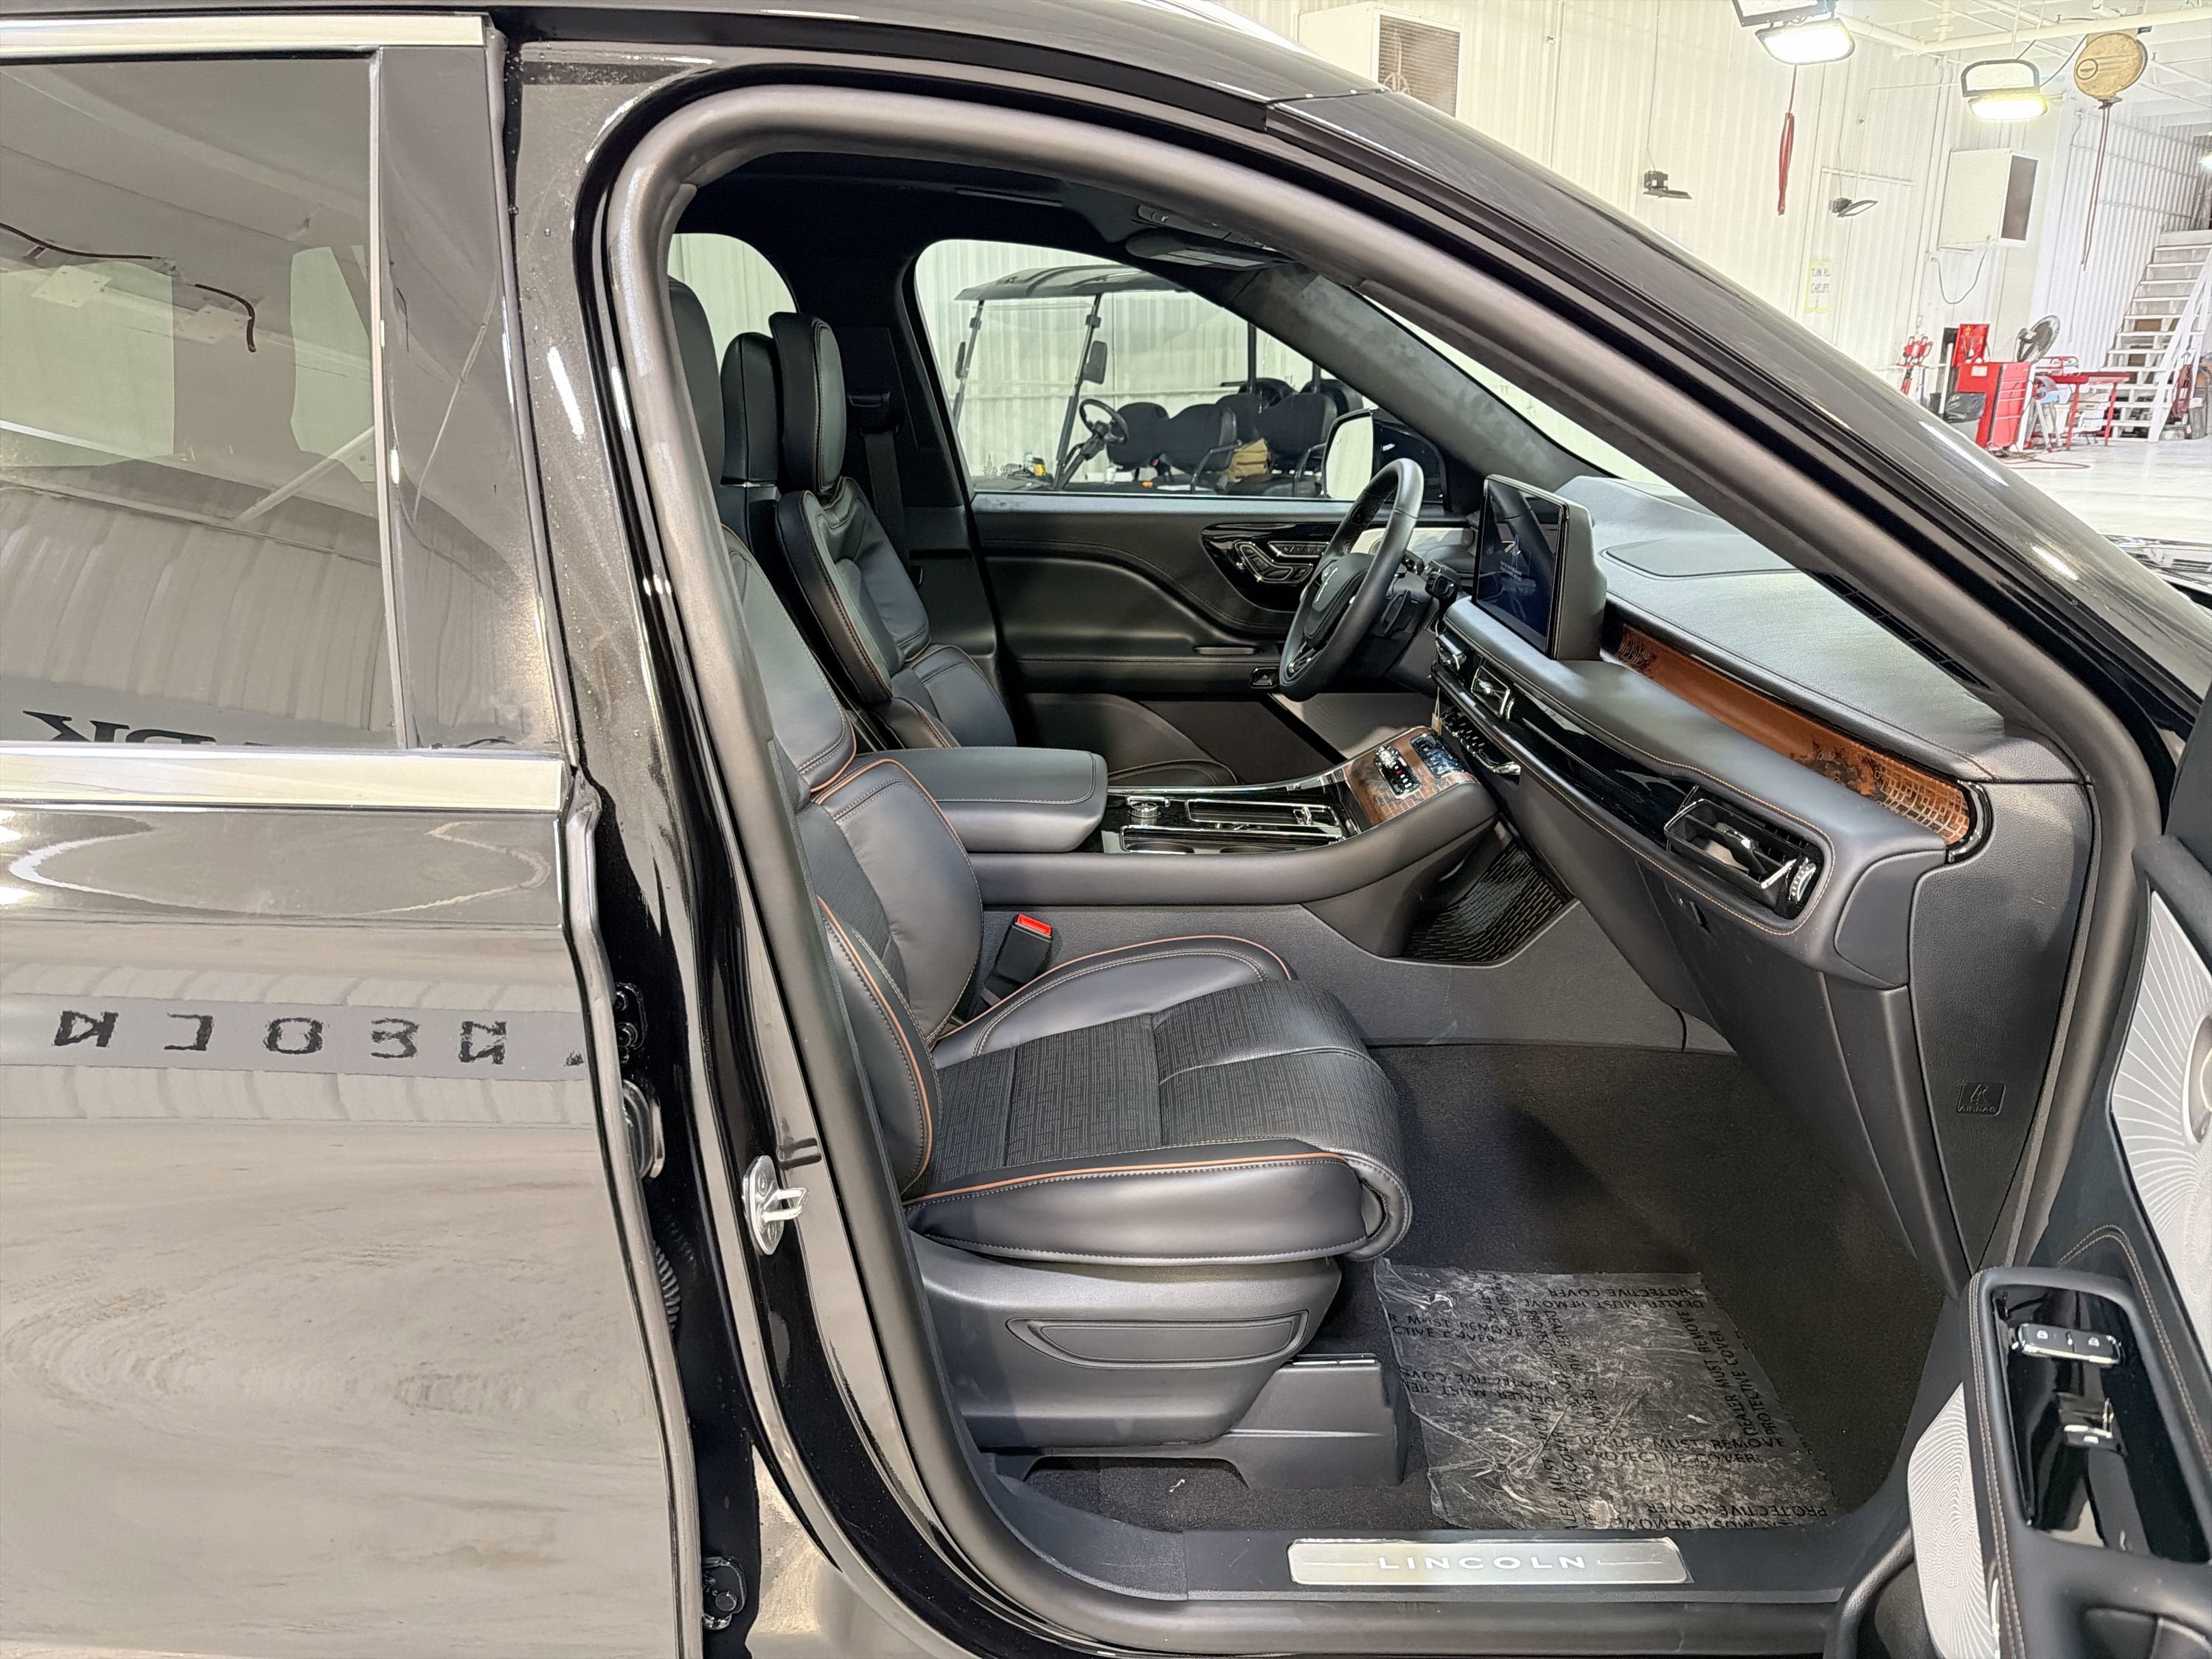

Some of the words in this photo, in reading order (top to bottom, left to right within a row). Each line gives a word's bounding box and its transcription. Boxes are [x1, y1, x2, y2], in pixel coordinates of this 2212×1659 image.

[1548, 1288, 1600, 1298] COVER
[1523, 1298, 1587, 1310] REMOVE
[1596, 1299, 1637, 1309] MUST
[1677, 1310, 1711, 1353] REMOVE
[1708, 1330, 1739, 1366] COVER
[1704, 1358, 1731, 1388] MUST
[1732, 1371, 1776, 1436] PROTECTIVE
[1725, 1394, 1758, 1436] DEALER
[1652, 1438, 1703, 1450] MUST
[1711, 1436, 1785, 1451] REMOVE
[1541, 1457, 1566, 1492] MUST
[1649, 1504, 1709, 1515] COVER
[1720, 1504, 1828, 1517] PROTECTIVE
[1377, 1555, 1587, 1571] LINCOLN
